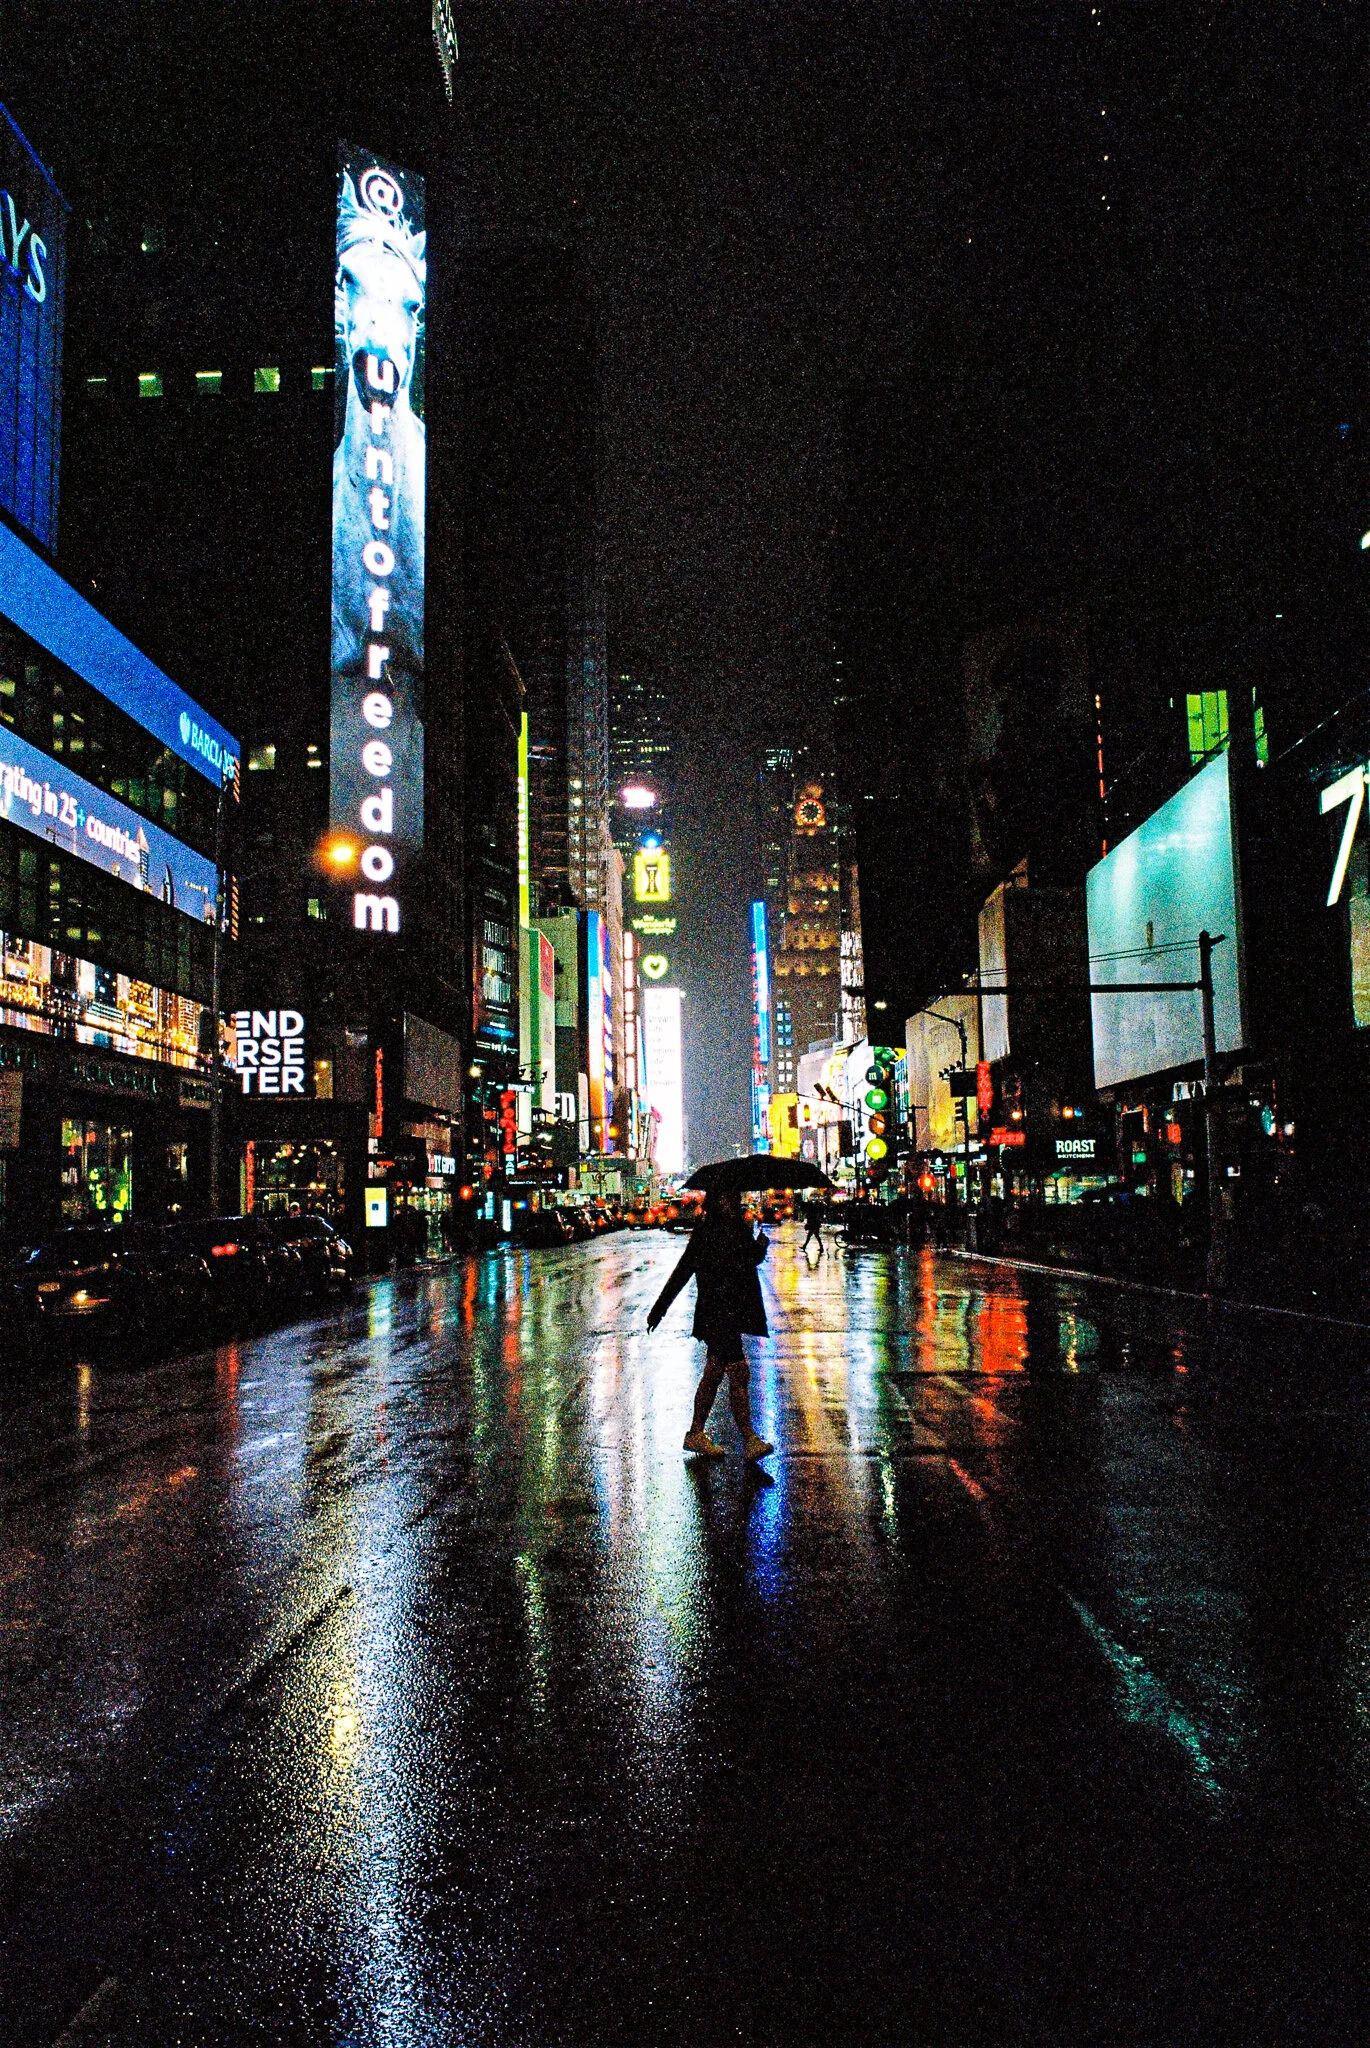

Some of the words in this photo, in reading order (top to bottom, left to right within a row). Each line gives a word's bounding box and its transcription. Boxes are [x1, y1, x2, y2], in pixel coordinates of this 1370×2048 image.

[0, 194, 47, 303] YS
[44, 782, 58, 817] in
[86, 815, 141, 865] countries
[235, 1010, 304, 1037] END
[237, 1038, 305, 1065] RSE
[235, 1066, 305, 1094] TER
[1055, 1140, 1096, 1153] ROAST
